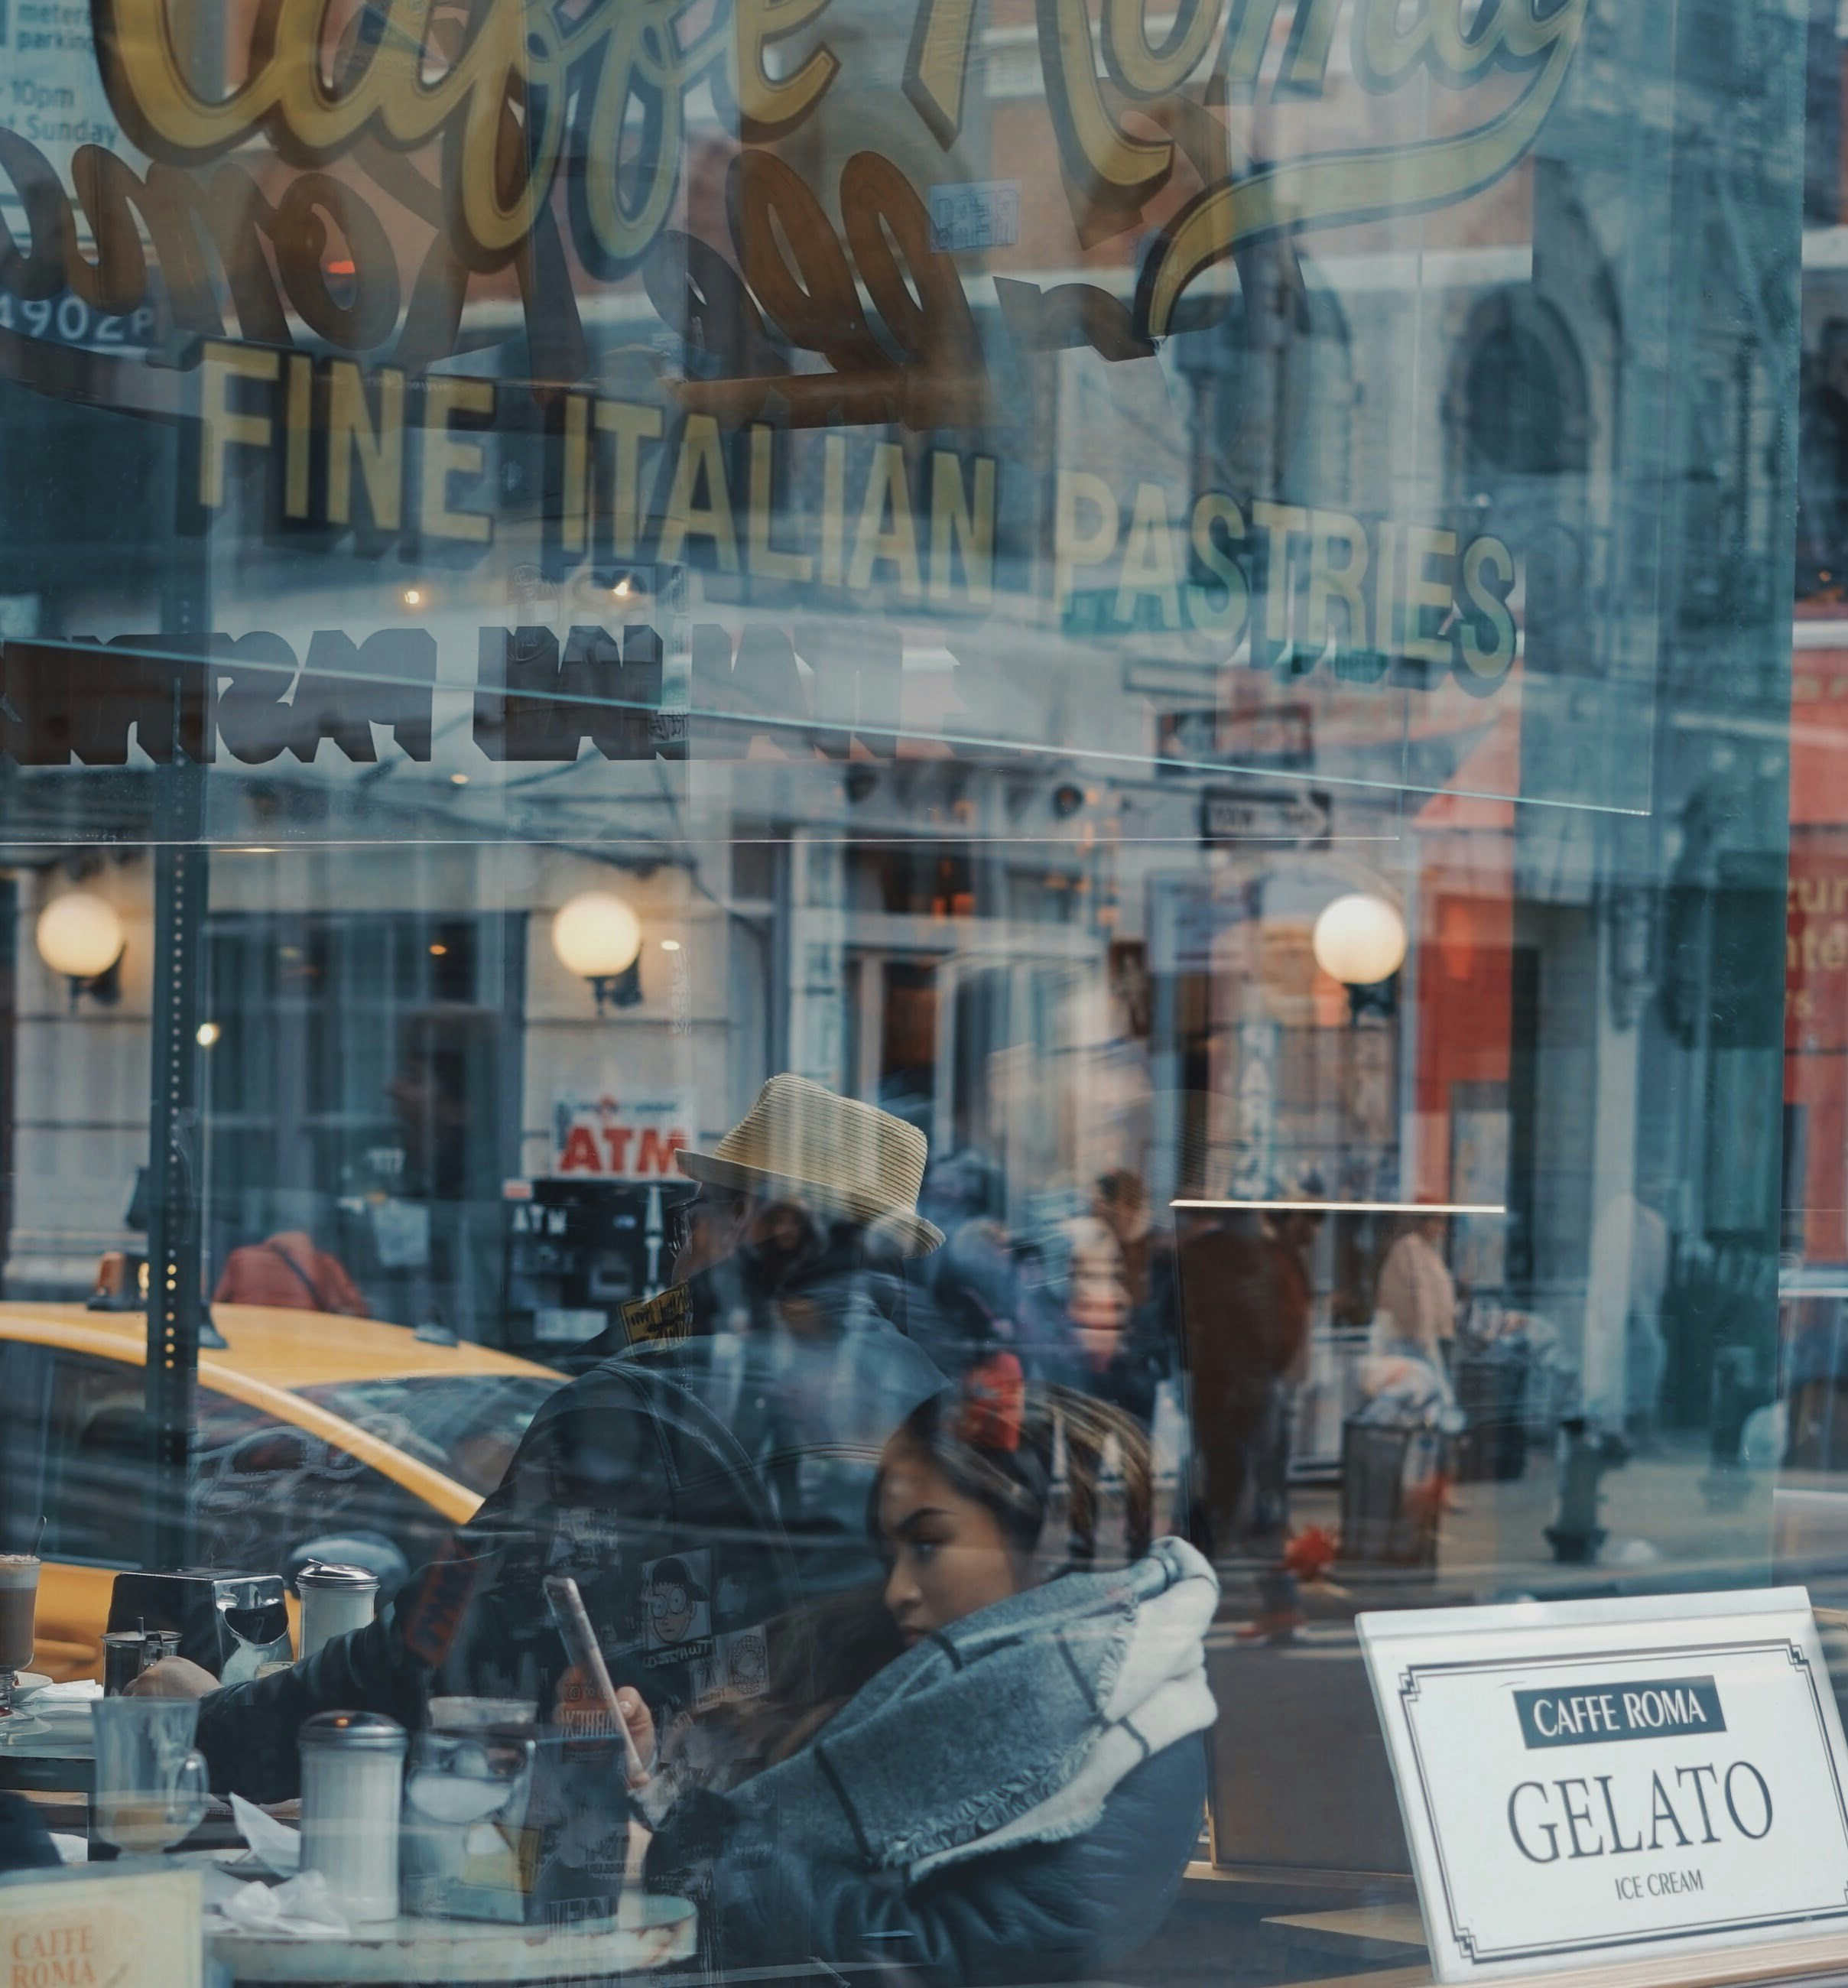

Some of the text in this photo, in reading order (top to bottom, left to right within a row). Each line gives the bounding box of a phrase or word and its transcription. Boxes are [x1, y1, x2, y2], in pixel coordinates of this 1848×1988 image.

[27, 114, 118, 148] Sunday
[199, 342, 1516, 682] FINE ITALIAN PASTRIES
[559, 1126, 688, 1173] ATM
[1532, 1688, 1707, 1737] CAFFE ROMA
[1506, 1760, 1774, 1864] GELATO
[1614, 1869, 1704, 1900] ICE CREAM
[9, 1959, 96, 1988] ROMA
